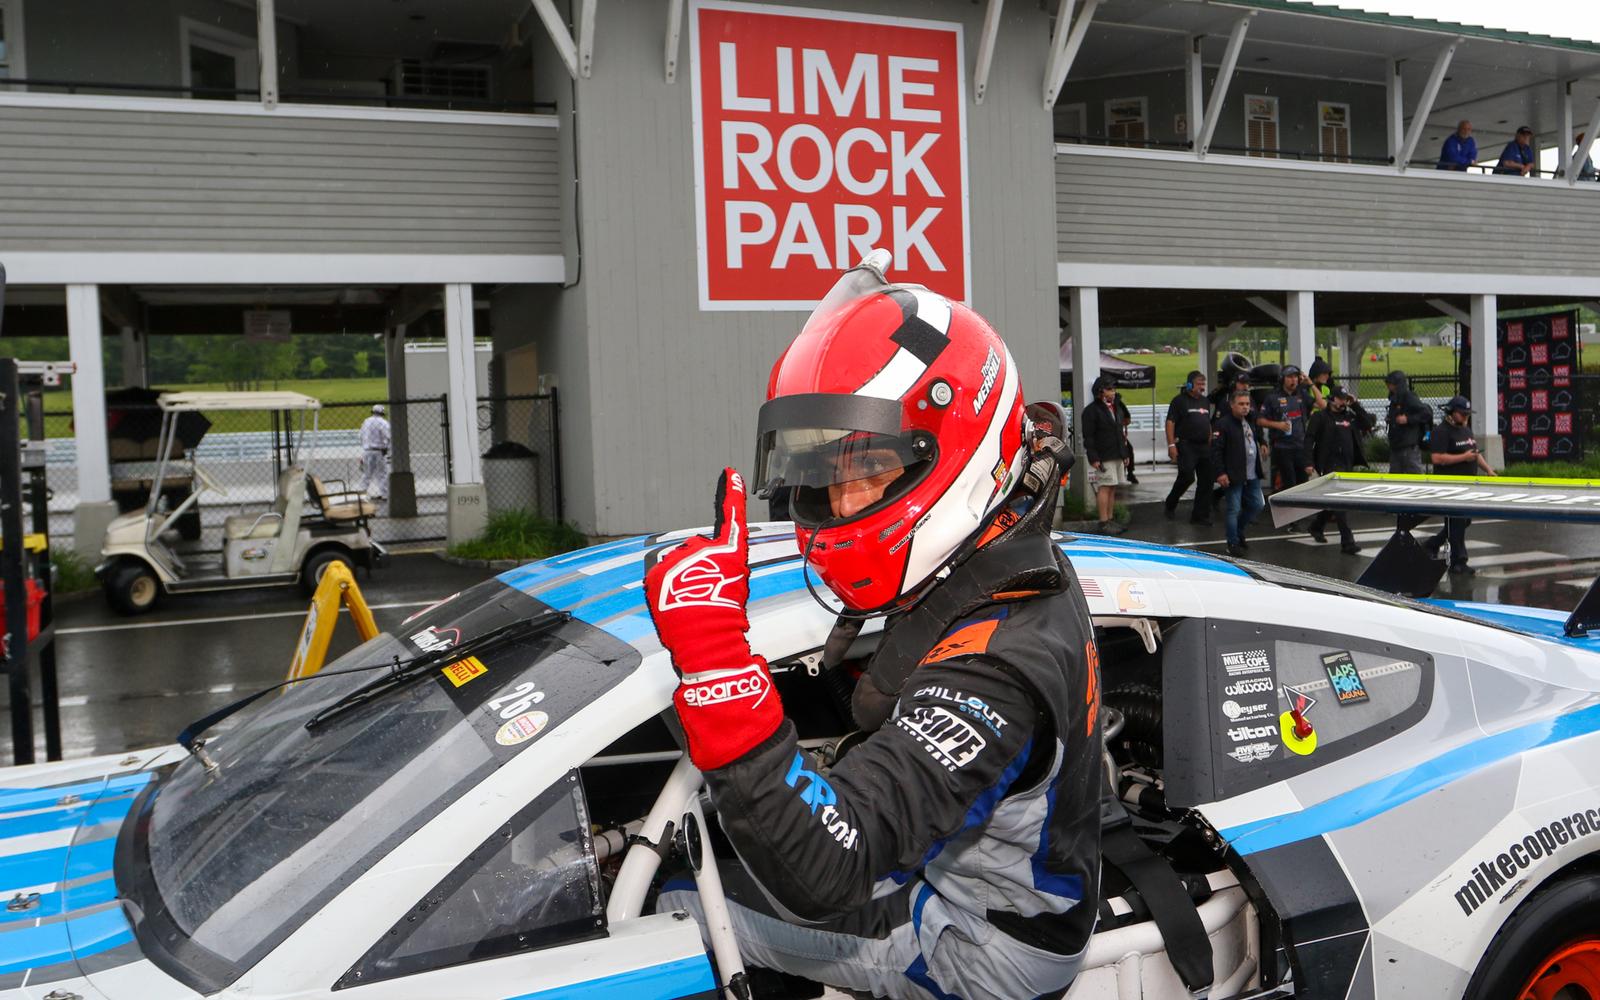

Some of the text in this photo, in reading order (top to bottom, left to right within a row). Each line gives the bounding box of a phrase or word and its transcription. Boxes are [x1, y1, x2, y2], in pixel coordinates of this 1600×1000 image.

[719, 41, 942, 124] LIME
[721, 120, 946, 198] ROCK
[724, 200, 947, 272] PARK
[973, 351, 1001, 416] MERRILL
[457, 495, 481, 506] 1998
[1223, 655, 1269, 667] MIKE COPE
[1327, 663, 1356, 679] LAPS
[487, 682, 545, 719] 26
[683, 675, 762, 707] sparco
[1225, 677, 1274, 696] wilwood
[1332, 675, 1363, 695] FOR
[1227, 725, 1278, 742] tilton
[1454, 807, 1600, 917] mikecoperac
